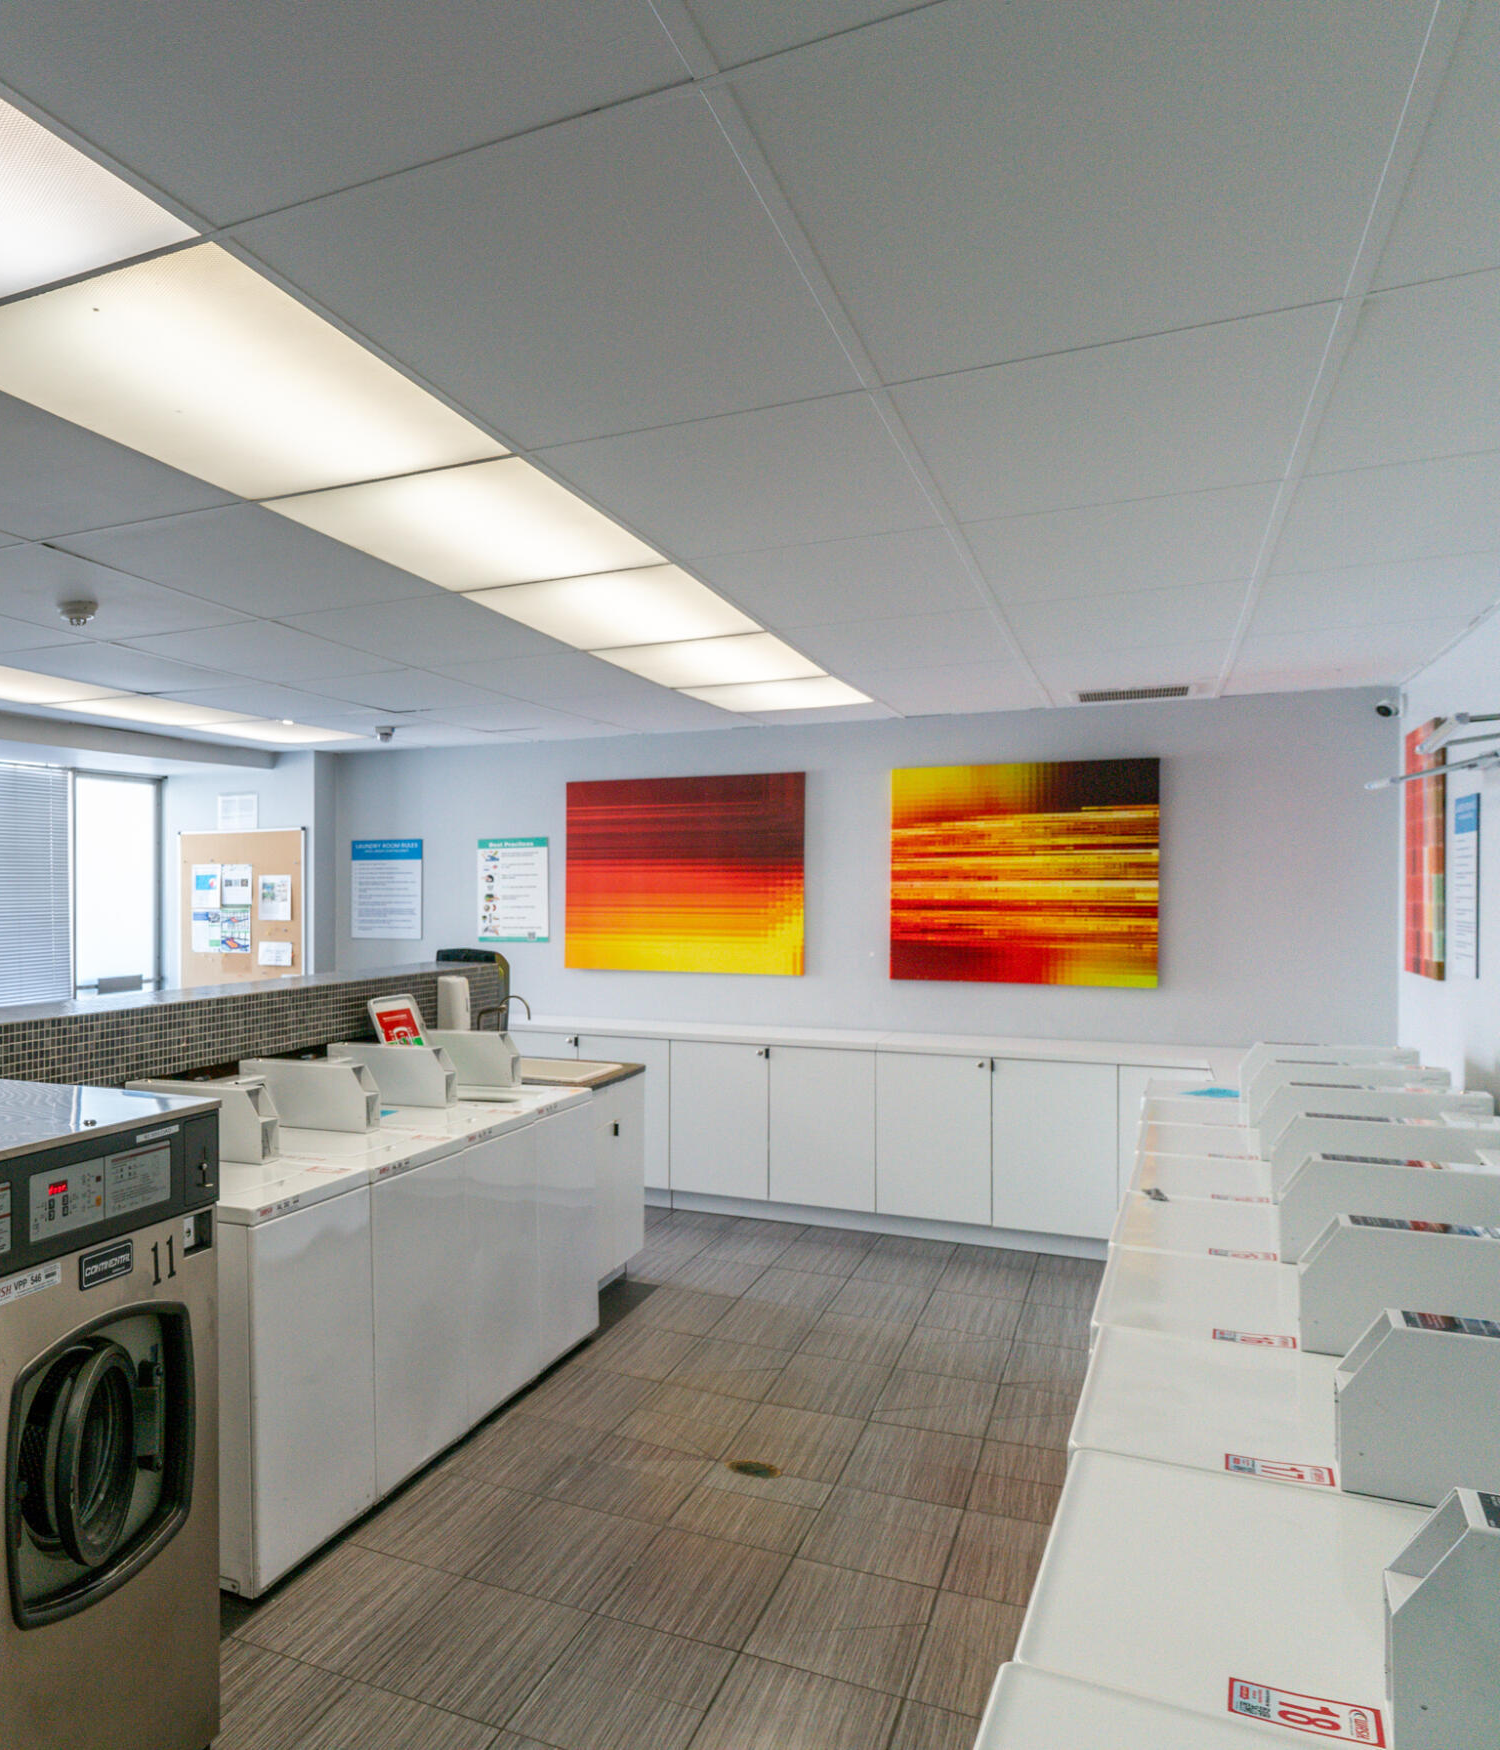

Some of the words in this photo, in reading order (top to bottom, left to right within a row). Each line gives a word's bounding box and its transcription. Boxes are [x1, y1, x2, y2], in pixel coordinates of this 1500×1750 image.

[151, 1234, 176, 1286] 11
[1261, 1465, 1305, 1479] 17
[1277, 1701, 1341, 1731] 18
